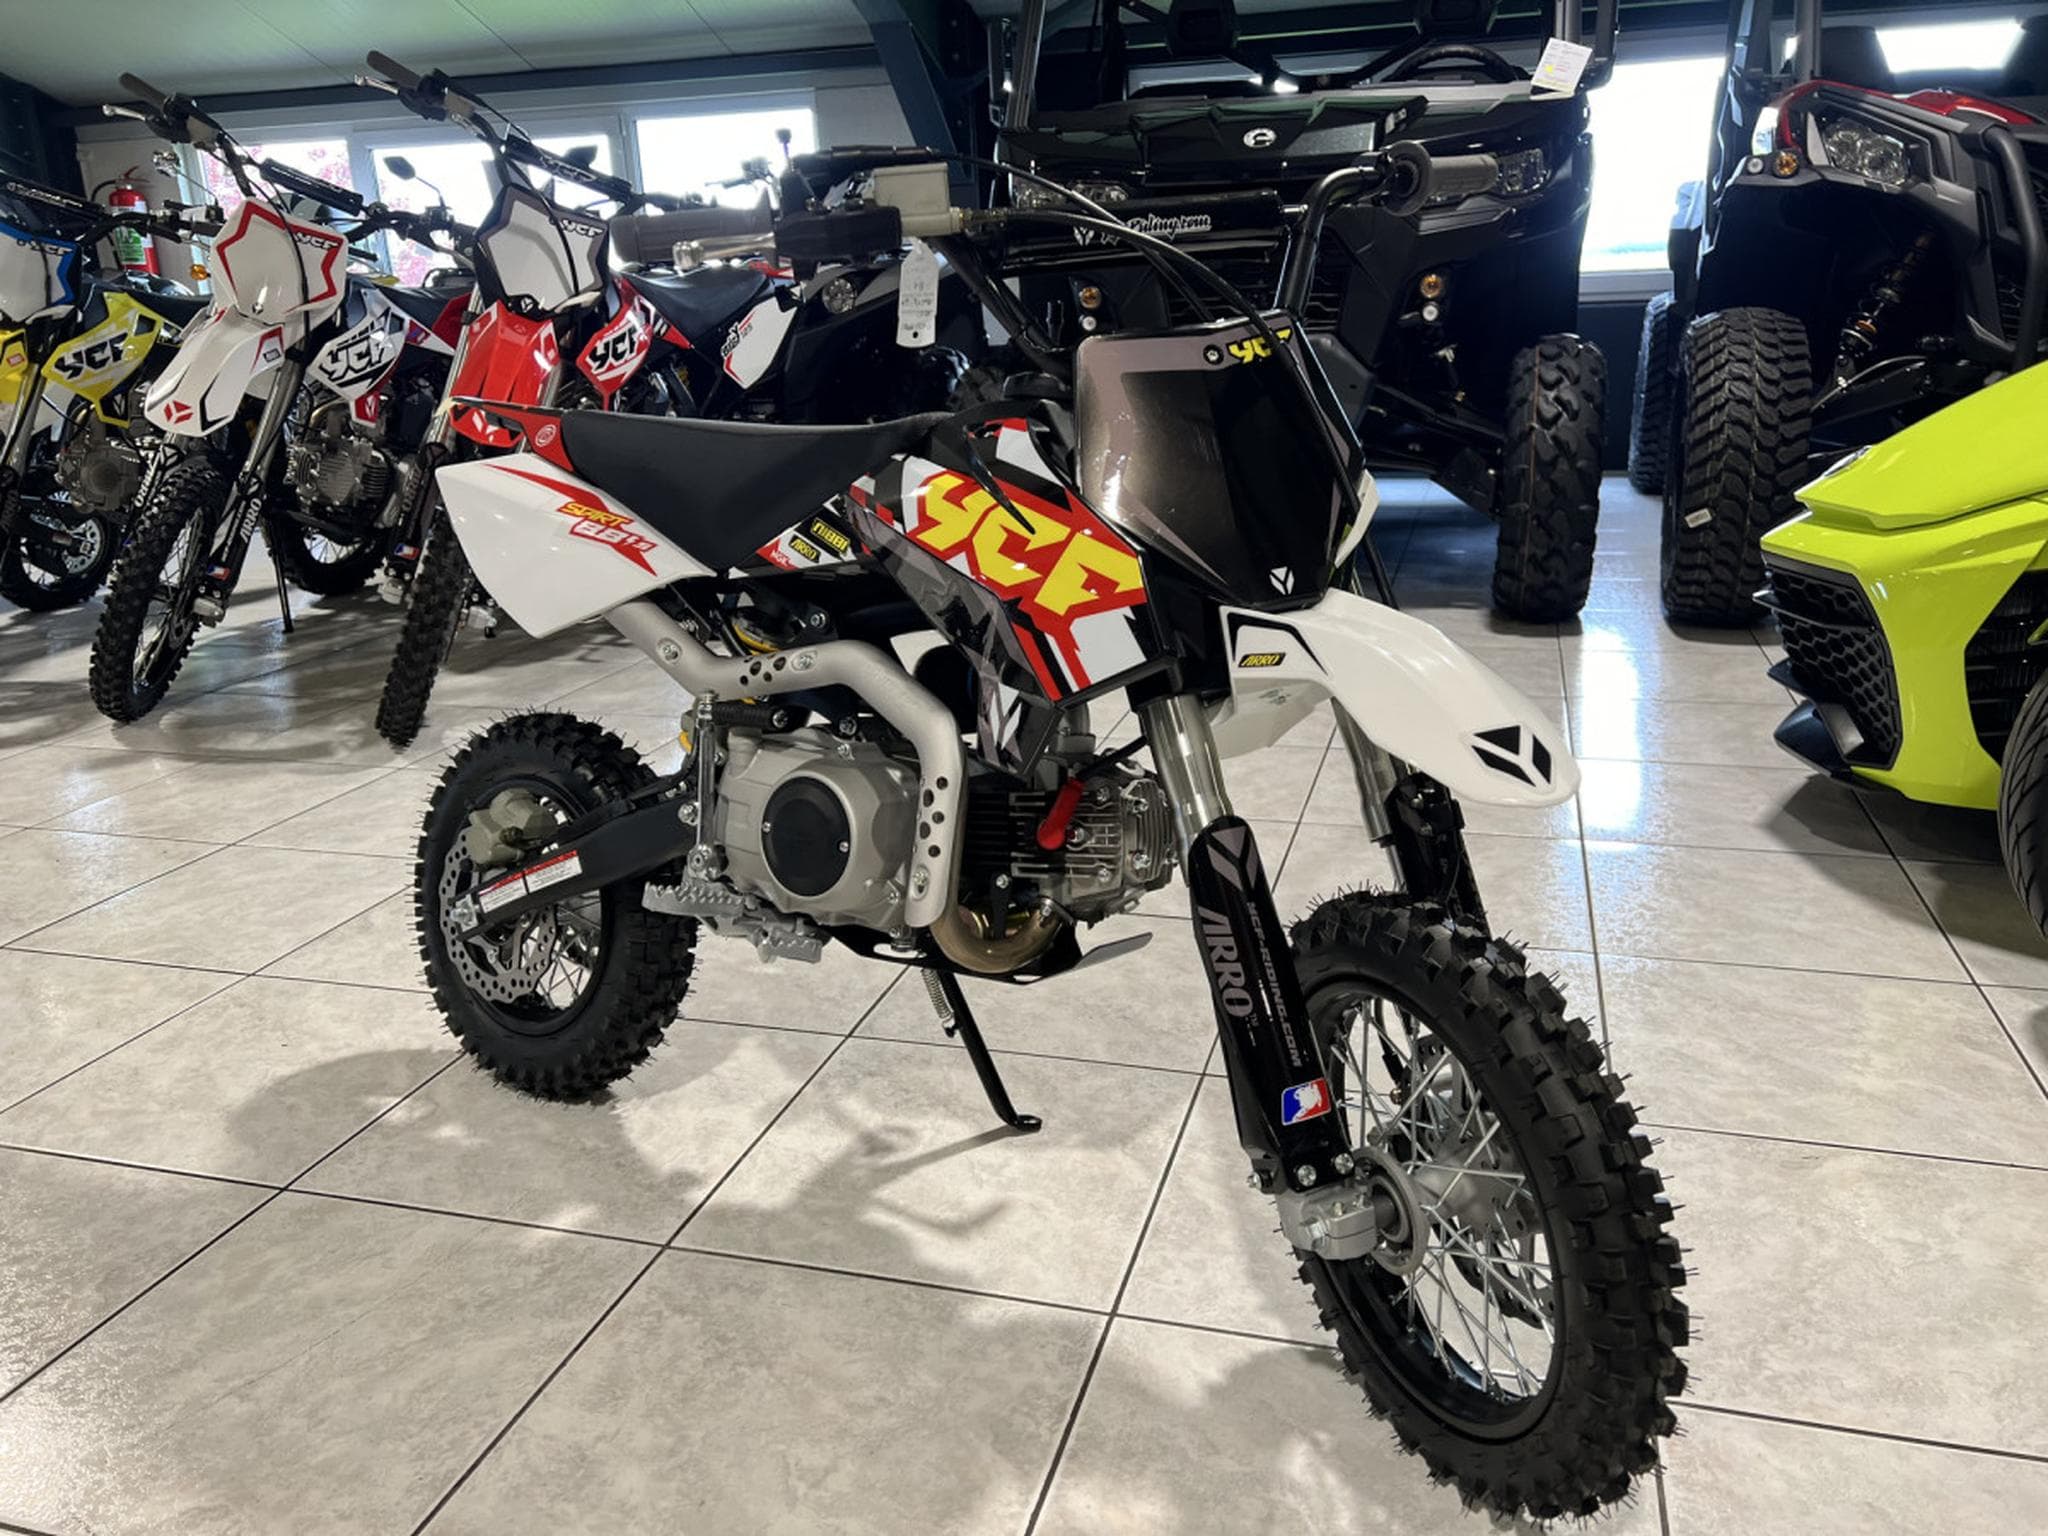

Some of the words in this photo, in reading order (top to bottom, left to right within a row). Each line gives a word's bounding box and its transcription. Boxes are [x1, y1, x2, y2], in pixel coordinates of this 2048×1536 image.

[297, 231, 339, 250] YCF
[562, 219, 603, 237] YCF
[54, 332, 128, 380] YCF
[318, 330, 394, 383] YCF
[588, 326, 638, 372] YCF
[1228, 328, 1291, 364] YC
[240, 498, 262, 543] ARRO
[561, 501, 633, 527] START
[790, 538, 818, 561] ARRO
[917, 473, 1144, 616] YCF
[1240, 654, 1281, 667] ARRO
[1197, 906, 1253, 1017] ARRO
